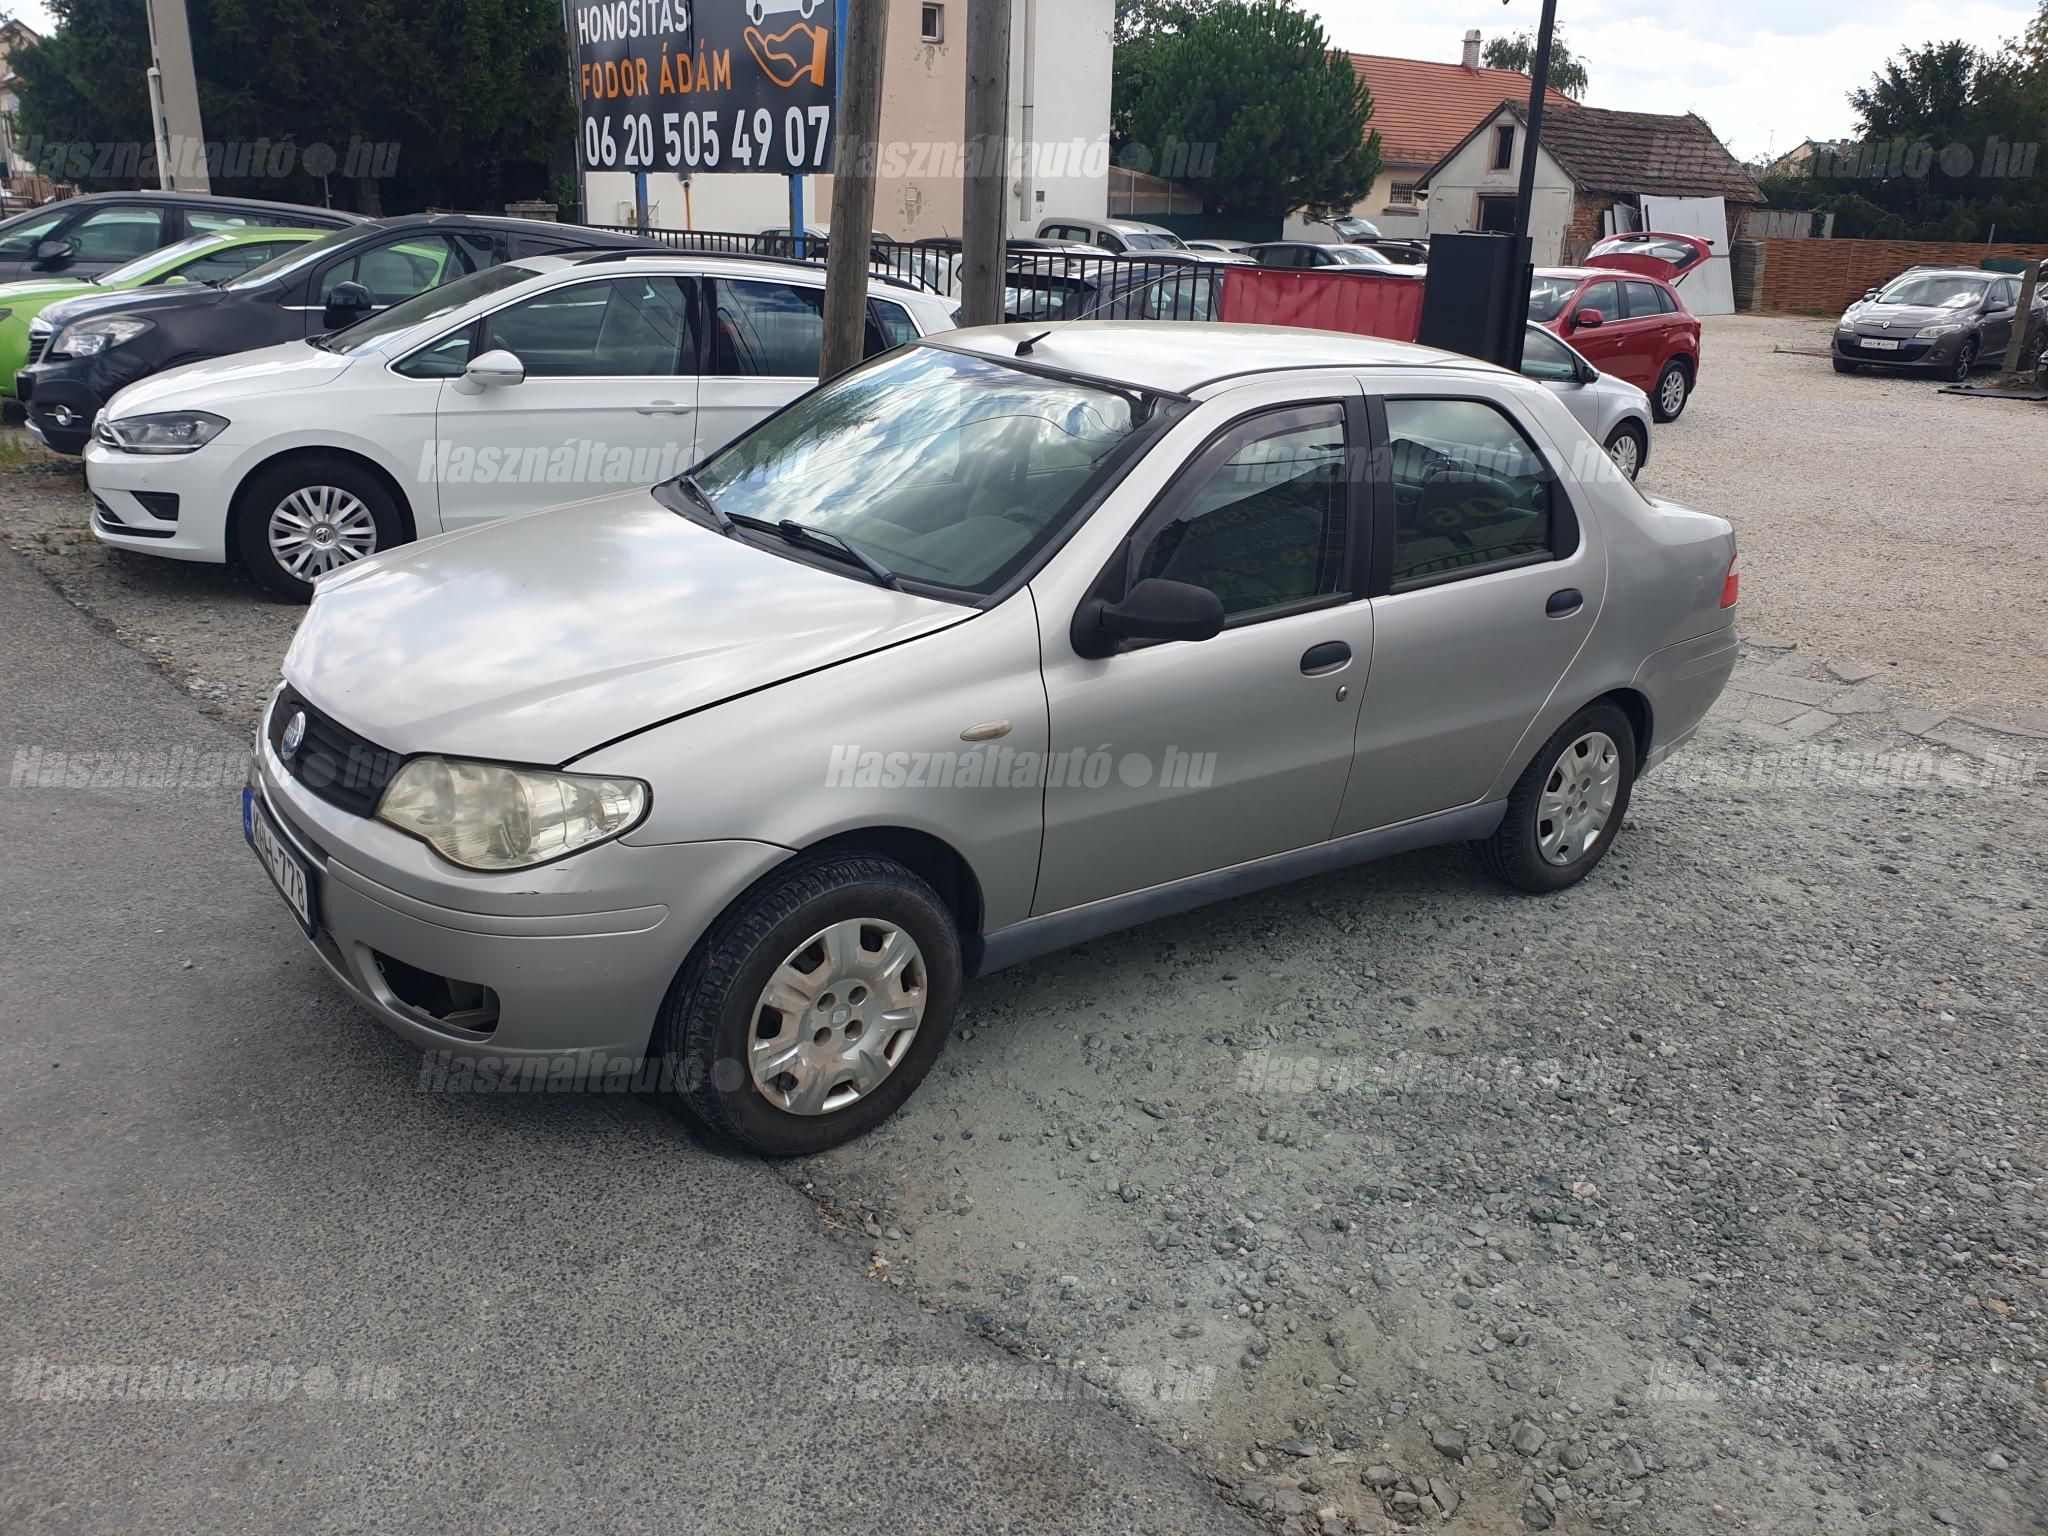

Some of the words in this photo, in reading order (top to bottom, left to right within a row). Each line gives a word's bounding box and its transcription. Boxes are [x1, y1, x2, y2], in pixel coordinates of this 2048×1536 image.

[582, 56, 650, 100] FODOR
[659, 38, 731, 94] ÁDÁM
[585, 116, 616, 166] 06
[623, 113, 653, 166] 20
[663, 110, 719, 167] 505
[732, 108, 772, 166] 49
[785, 105, 829, 167] 07
